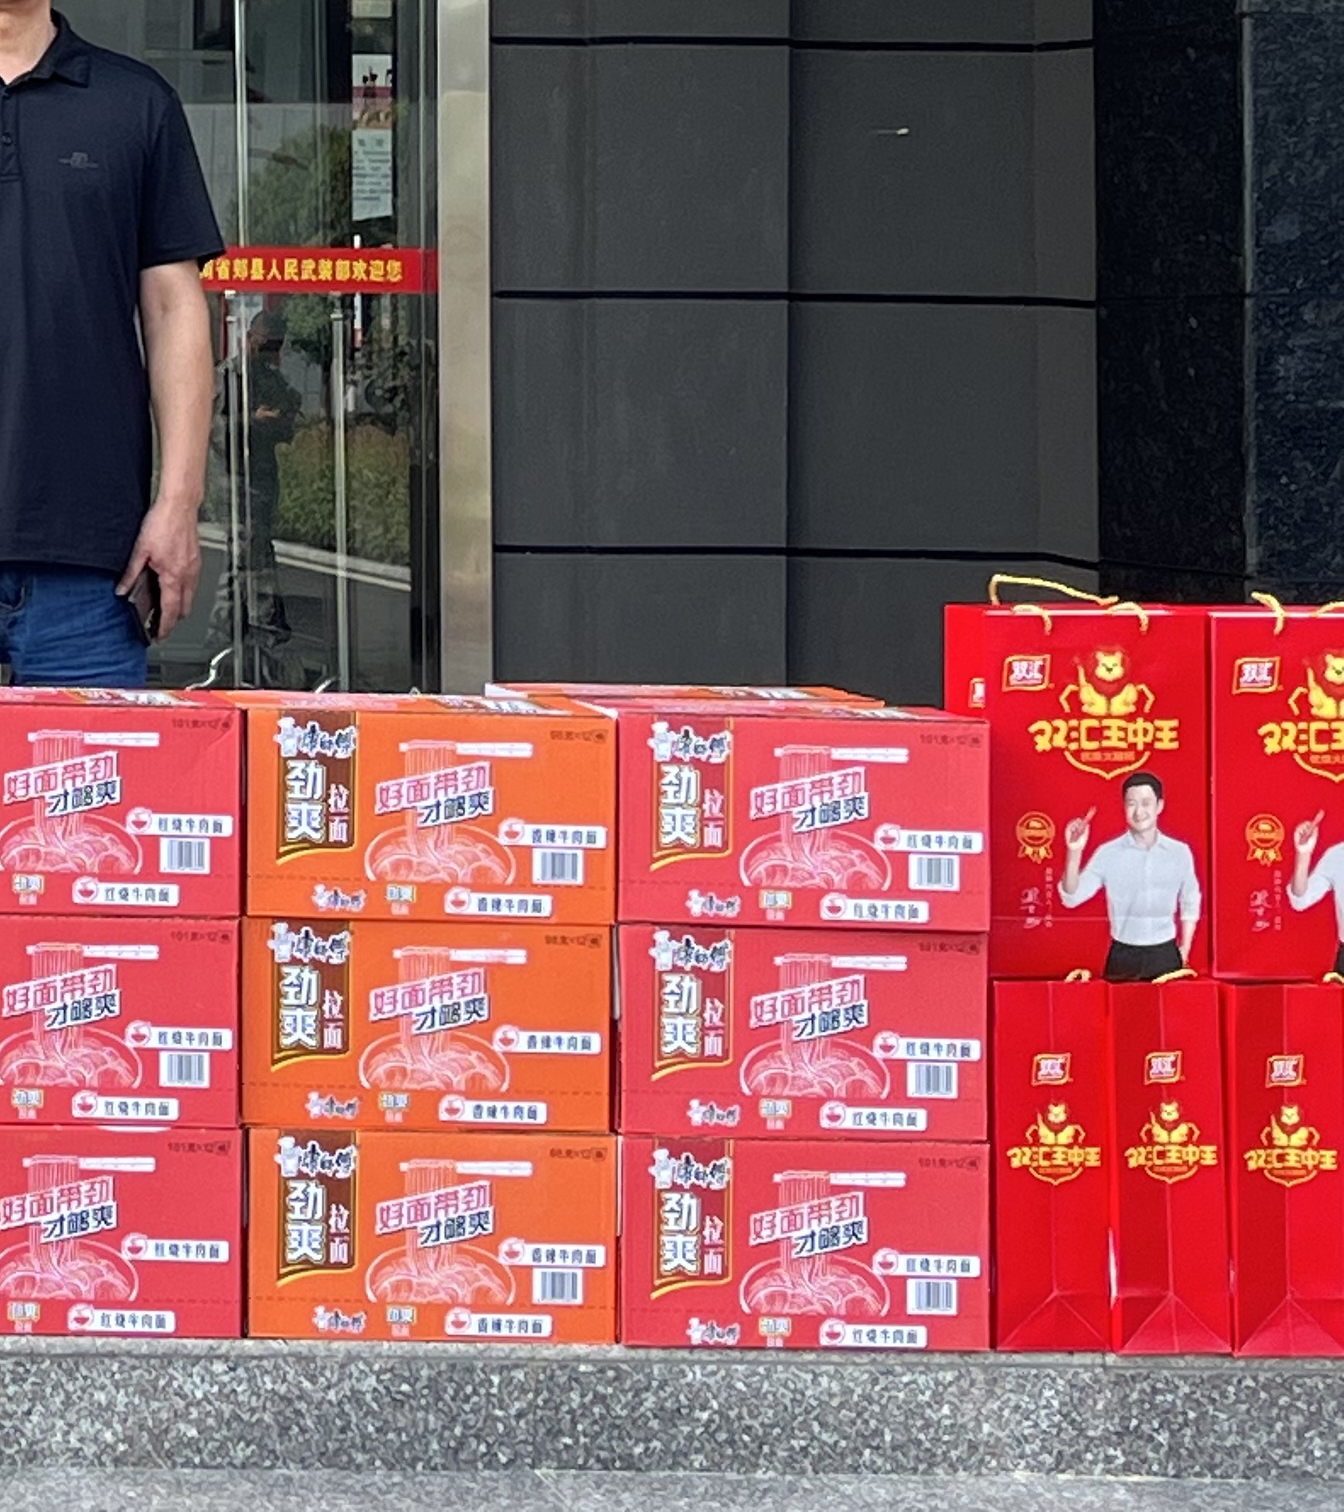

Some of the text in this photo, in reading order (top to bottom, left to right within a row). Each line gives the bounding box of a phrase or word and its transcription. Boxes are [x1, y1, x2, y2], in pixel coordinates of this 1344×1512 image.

[1028, 718, 1179, 752] 双汇王中王
[7, 755, 116, 798] 好面带劲
[47, 782, 120, 813] 才够爽
[378, 765, 489, 809] 好面带劲
[753, 770, 864, 814] 好面带劲
[285, 759, 326, 842] 劲爽
[328, 785, 350, 843] 拉面
[419, 792, 494, 824] 才够爽
[659, 764, 700, 847] 劲爽
[702, 789, 725, 848] 拉面
[794, 797, 869, 829] 才够爽
[7, 968, 116, 1011] 好面带劲
[46, 995, 119, 1026] 才够爽
[279, 965, 320, 1048] 劲爽
[373, 971, 484, 1015] 好面带劲
[753, 978, 864, 1022] 好面带劲
[322, 990, 345, 1049] 拉面
[414, 998, 489, 1030] 才够爽
[660, 973, 701, 1056] 劲爽
[703, 999, 725, 1057] 拉面
[794, 1005, 869, 1037] 才够爽
[1007, 1144, 1101, 1168] 双汇王中王
[1124, 1145, 1218, 1168] 双汇王中王
[1244, 1148, 1337, 1171] 双汇王中王
[2, 1179, 113, 1223] 好面带劲
[43, 1207, 116, 1238] 才够爽
[285, 1180, 326, 1263] 劲爽
[380, 1185, 489, 1228] 好面带劲
[752, 1195, 863, 1239] 好面带劲
[328, 1205, 351, 1264] 拉面
[419, 1212, 494, 1244] 才够爽
[660, 1191, 701, 1274] 劲爽
[702, 1216, 725, 1275] 拉面
[793, 1222, 868, 1254] 才够爽
